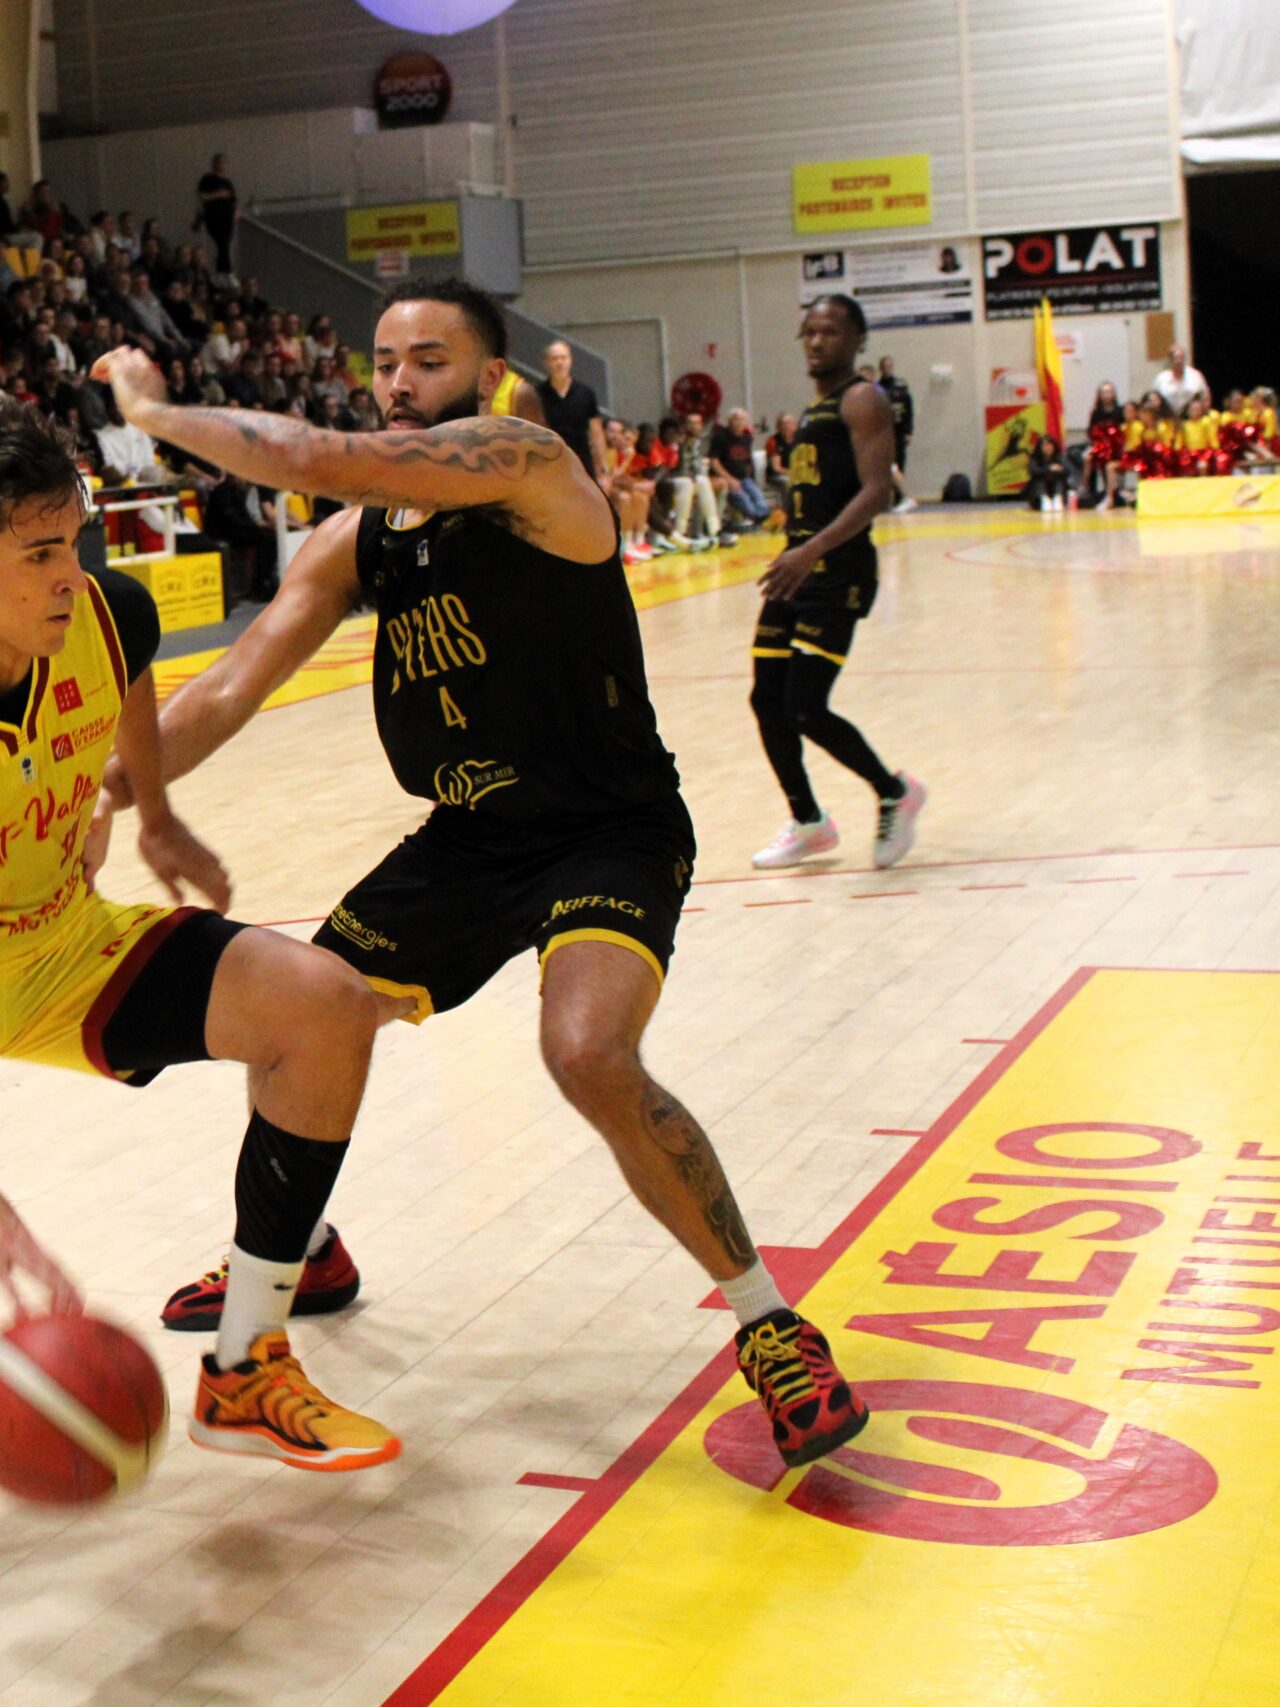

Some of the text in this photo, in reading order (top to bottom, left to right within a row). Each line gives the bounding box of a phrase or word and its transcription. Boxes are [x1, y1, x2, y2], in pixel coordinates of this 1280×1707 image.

[378, 75, 444, 94] SPORT
[386, 93, 440, 111] 2000
[984, 226, 1157, 279] POLAT
[439, 686, 467, 729] 4
[474, 766, 516, 786] SUR MER
